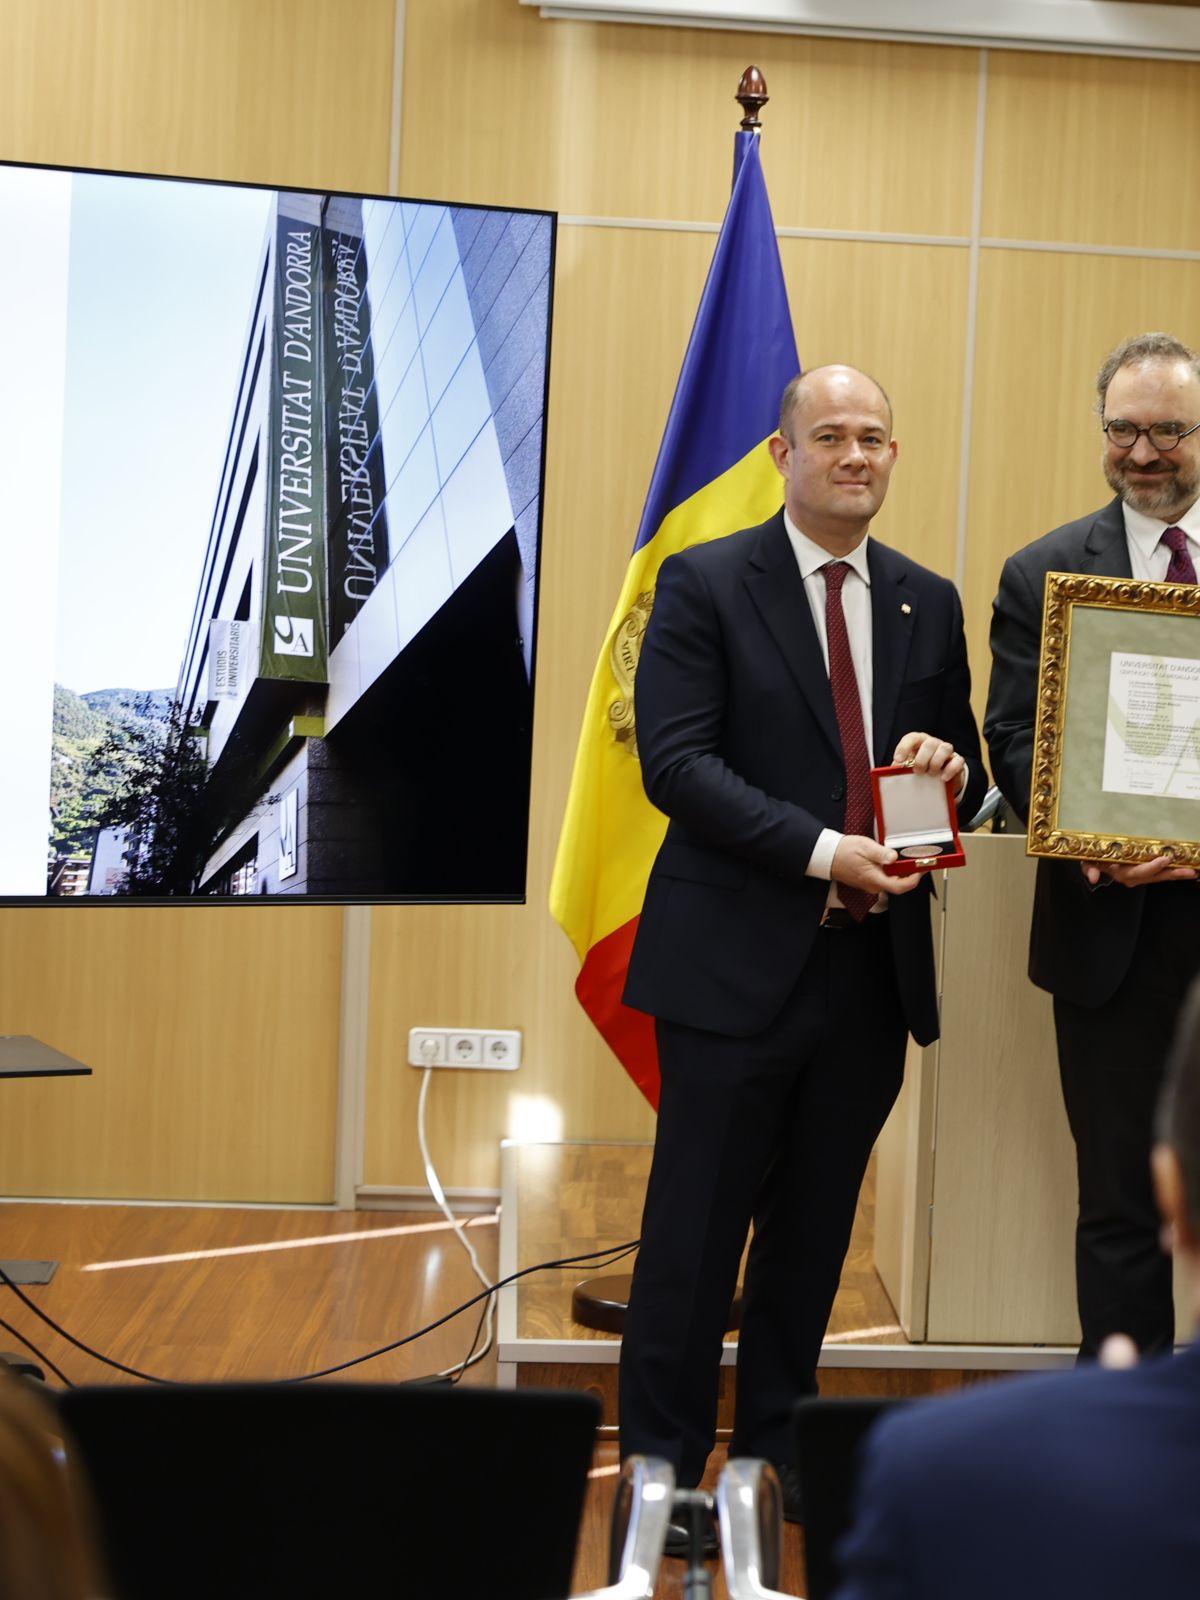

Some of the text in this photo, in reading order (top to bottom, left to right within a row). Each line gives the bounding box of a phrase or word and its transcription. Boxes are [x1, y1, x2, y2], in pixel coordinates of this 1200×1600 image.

[277, 231, 313, 594] UNIVERSITAT D'ANDORRA
[215, 649, 228, 688] ESTUDIS
[227, 621, 240, 688] UNIVERSITARIS
